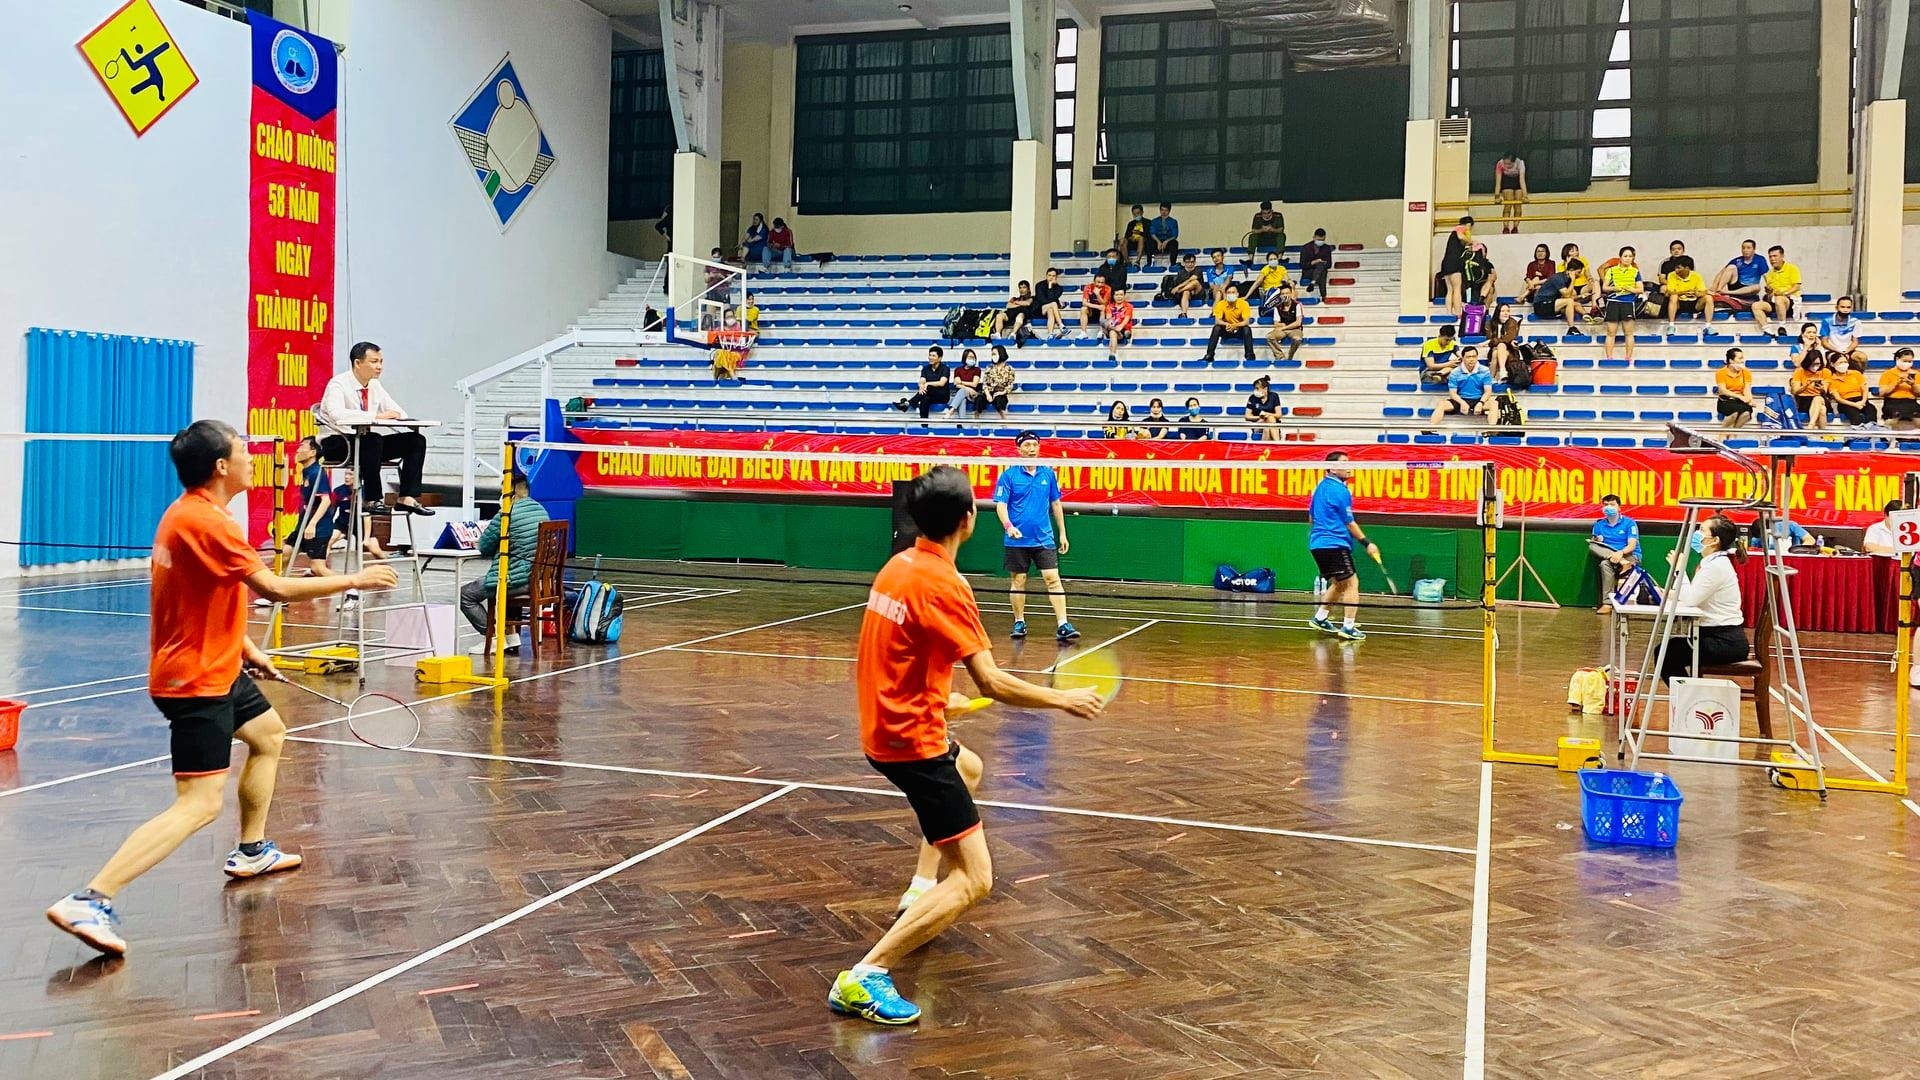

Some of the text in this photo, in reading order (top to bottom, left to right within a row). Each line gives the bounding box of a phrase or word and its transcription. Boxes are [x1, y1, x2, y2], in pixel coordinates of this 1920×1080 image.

[256, 119, 335, 174] CHÀO MỪNG
[268, 181, 319, 225] 58 NĂM
[276, 236, 312, 278] NGÀY
[256, 289, 327, 341] THÀNH LẬP
[277, 342, 308, 387] TỈNH
[250, 397, 297, 442] QUẢNG
[597, 441, 643, 477] CHÀO
[649, 442, 701, 479] MỪNG
[706, 453, 738, 486] ĐẠI
[742, 438, 784, 481] BIỂU
[789, 444, 813, 482] VÀ
[818, 446, 855, 489] VẬN
[860, 446, 913, 490] ĐỘNG
[1089, 451, 1124, 498] HỘI
[1131, 453, 1174, 493] VĂN
[1179, 454, 1222, 494] HÓA
[1231, 449, 1268, 496] THỂ
[1277, 467, 1324, 497] THA
[1501, 456, 1585, 506] QUẢNG
[1592, 470, 1656, 505] NINH
[1663, 458, 1714, 507] LẦN
[1834, 466, 1900, 513] NĂM
[1898, 521, 1920, 547] 3
